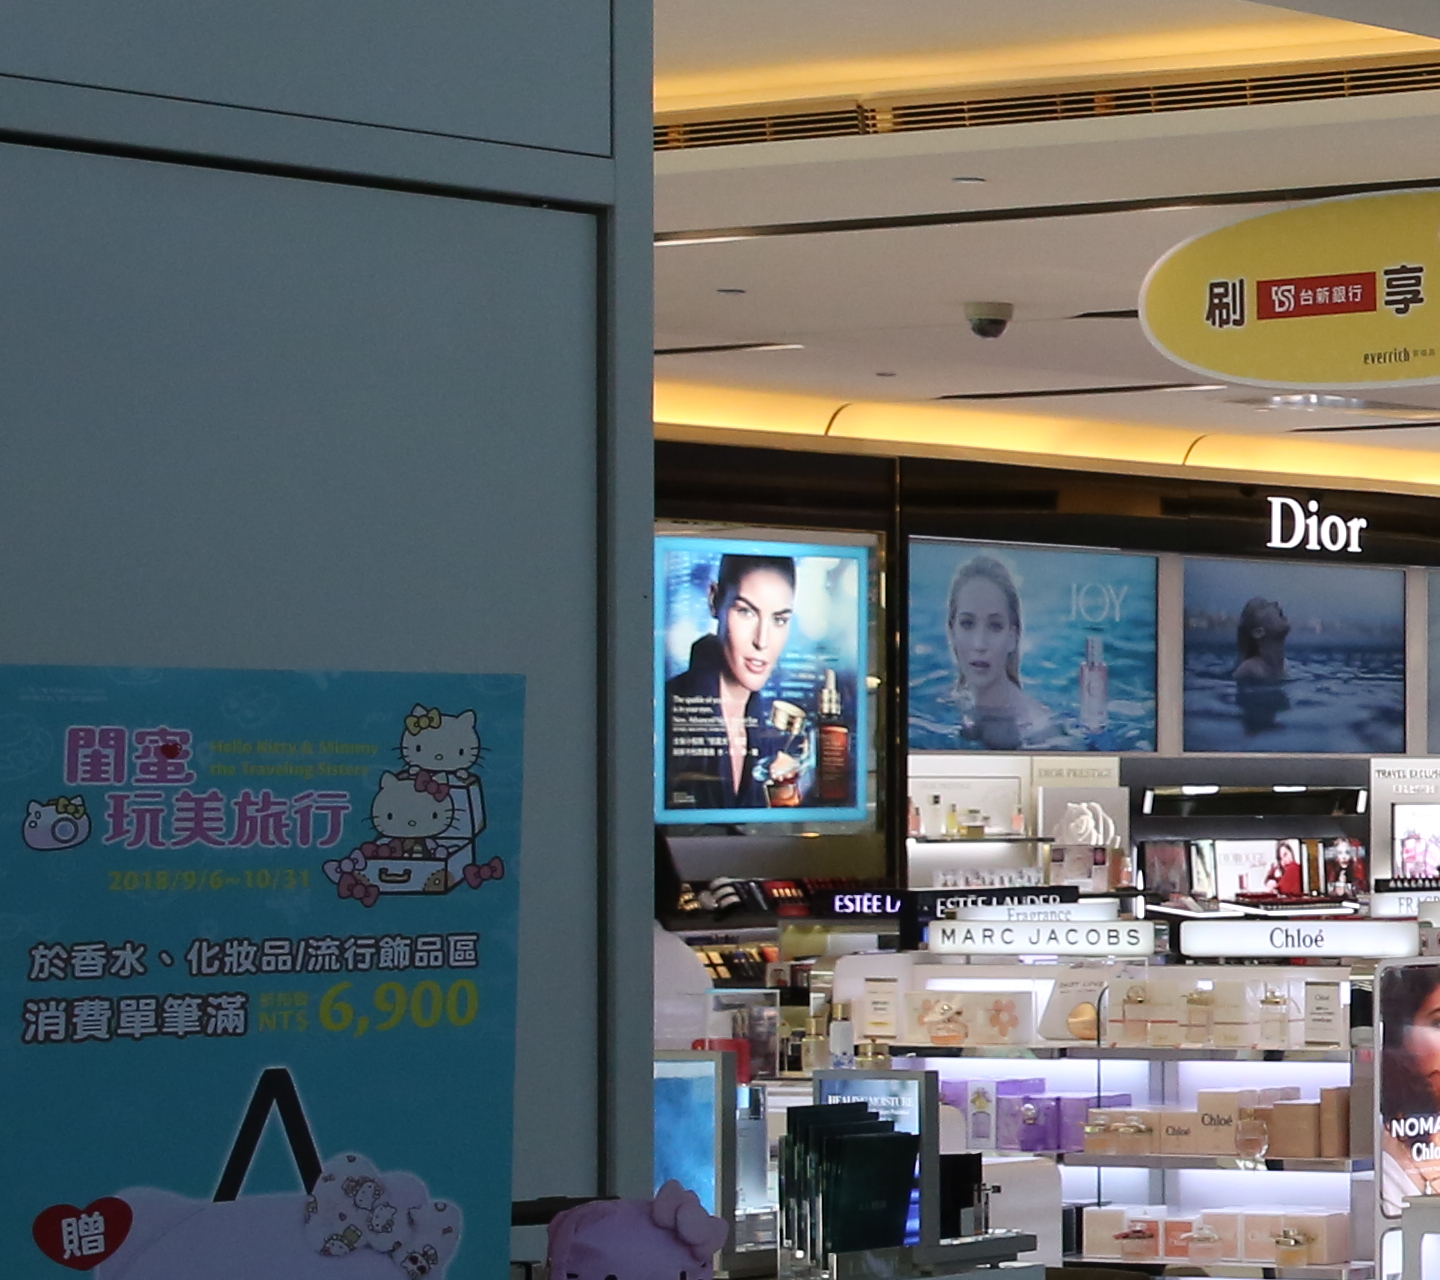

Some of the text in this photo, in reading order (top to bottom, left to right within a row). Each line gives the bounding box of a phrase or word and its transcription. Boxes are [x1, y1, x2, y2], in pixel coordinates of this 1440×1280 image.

[1205, 280, 1245, 327] 刷
[1300, 284, 1363, 305] 台新銀行
[1383, 265, 1424, 314] 享
[1267, 496, 1367, 553] Dior
[1069, 584, 1130, 622] JOY
[64, 725, 197, 786] 閨蜜
[1375, 769, 1407, 779] TRAVEL
[103, 790, 352, 848] 玩美旅行
[107, 868, 311, 893] 2018/9/6~10/31
[834, 892, 882, 913] ESTÉE
[936, 892, 1062, 915] ESTÉE LAUDER
[1007, 907, 1073, 921] Fragrance
[939, 927, 1142, 947] MARC JACOBS
[1268, 925, 1326, 951] Chloé
[21, 993, 249, 1046] 消費單筆滿
[258, 978, 480, 1038] NT$ 6,900
[869, 1095, 914, 1107] MOISTURE
[1165, 1126, 1191, 1136] Chloé
[1201, 1113, 1233, 1127] Chloé
[61, 1213, 106, 1258] 贈
